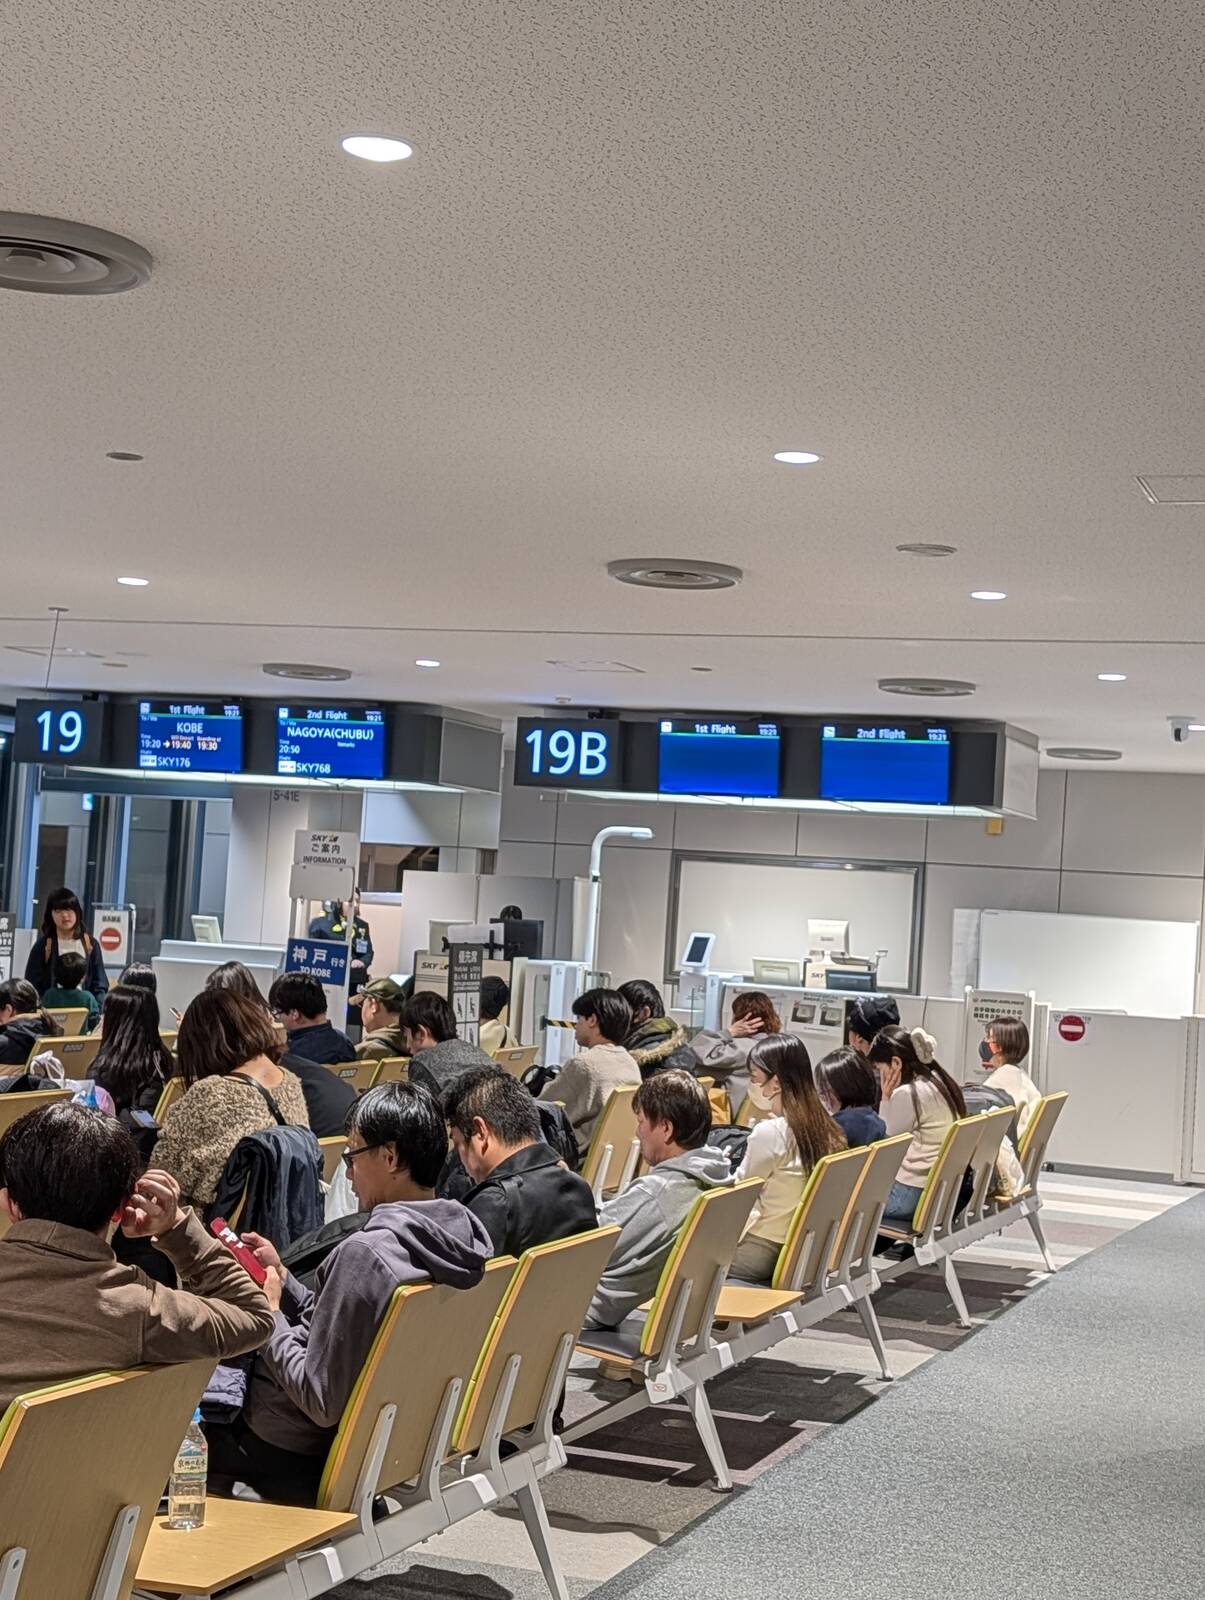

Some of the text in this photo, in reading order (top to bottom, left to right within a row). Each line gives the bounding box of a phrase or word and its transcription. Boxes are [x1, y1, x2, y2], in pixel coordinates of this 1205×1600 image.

[169, 705, 205, 715] 1st Flight
[306, 710, 347, 720] 2nd Flight
[36, 710, 82, 753] 19
[176, 722, 203, 734] KOBE
[287, 727, 374, 740] NAGOYA(CHUBU)
[694, 724, 736, 734] 1st Flight
[856, 728, 906, 739] 2nd Flight
[141, 739, 192, 750] 19:20 19:40
[279, 745, 300, 754] 20:50
[525, 729, 607, 775] 19B
[157, 756, 191, 768] SKY176
[296, 762, 331, 774] SKY768
[273, 790, 300, 802] S-41E
[311, 843, 341, 854] ご案内
[303, 855, 347, 865] INFORMATION
[292, 945, 328, 965] 神戸
[311, 967, 332, 978] KOBE
